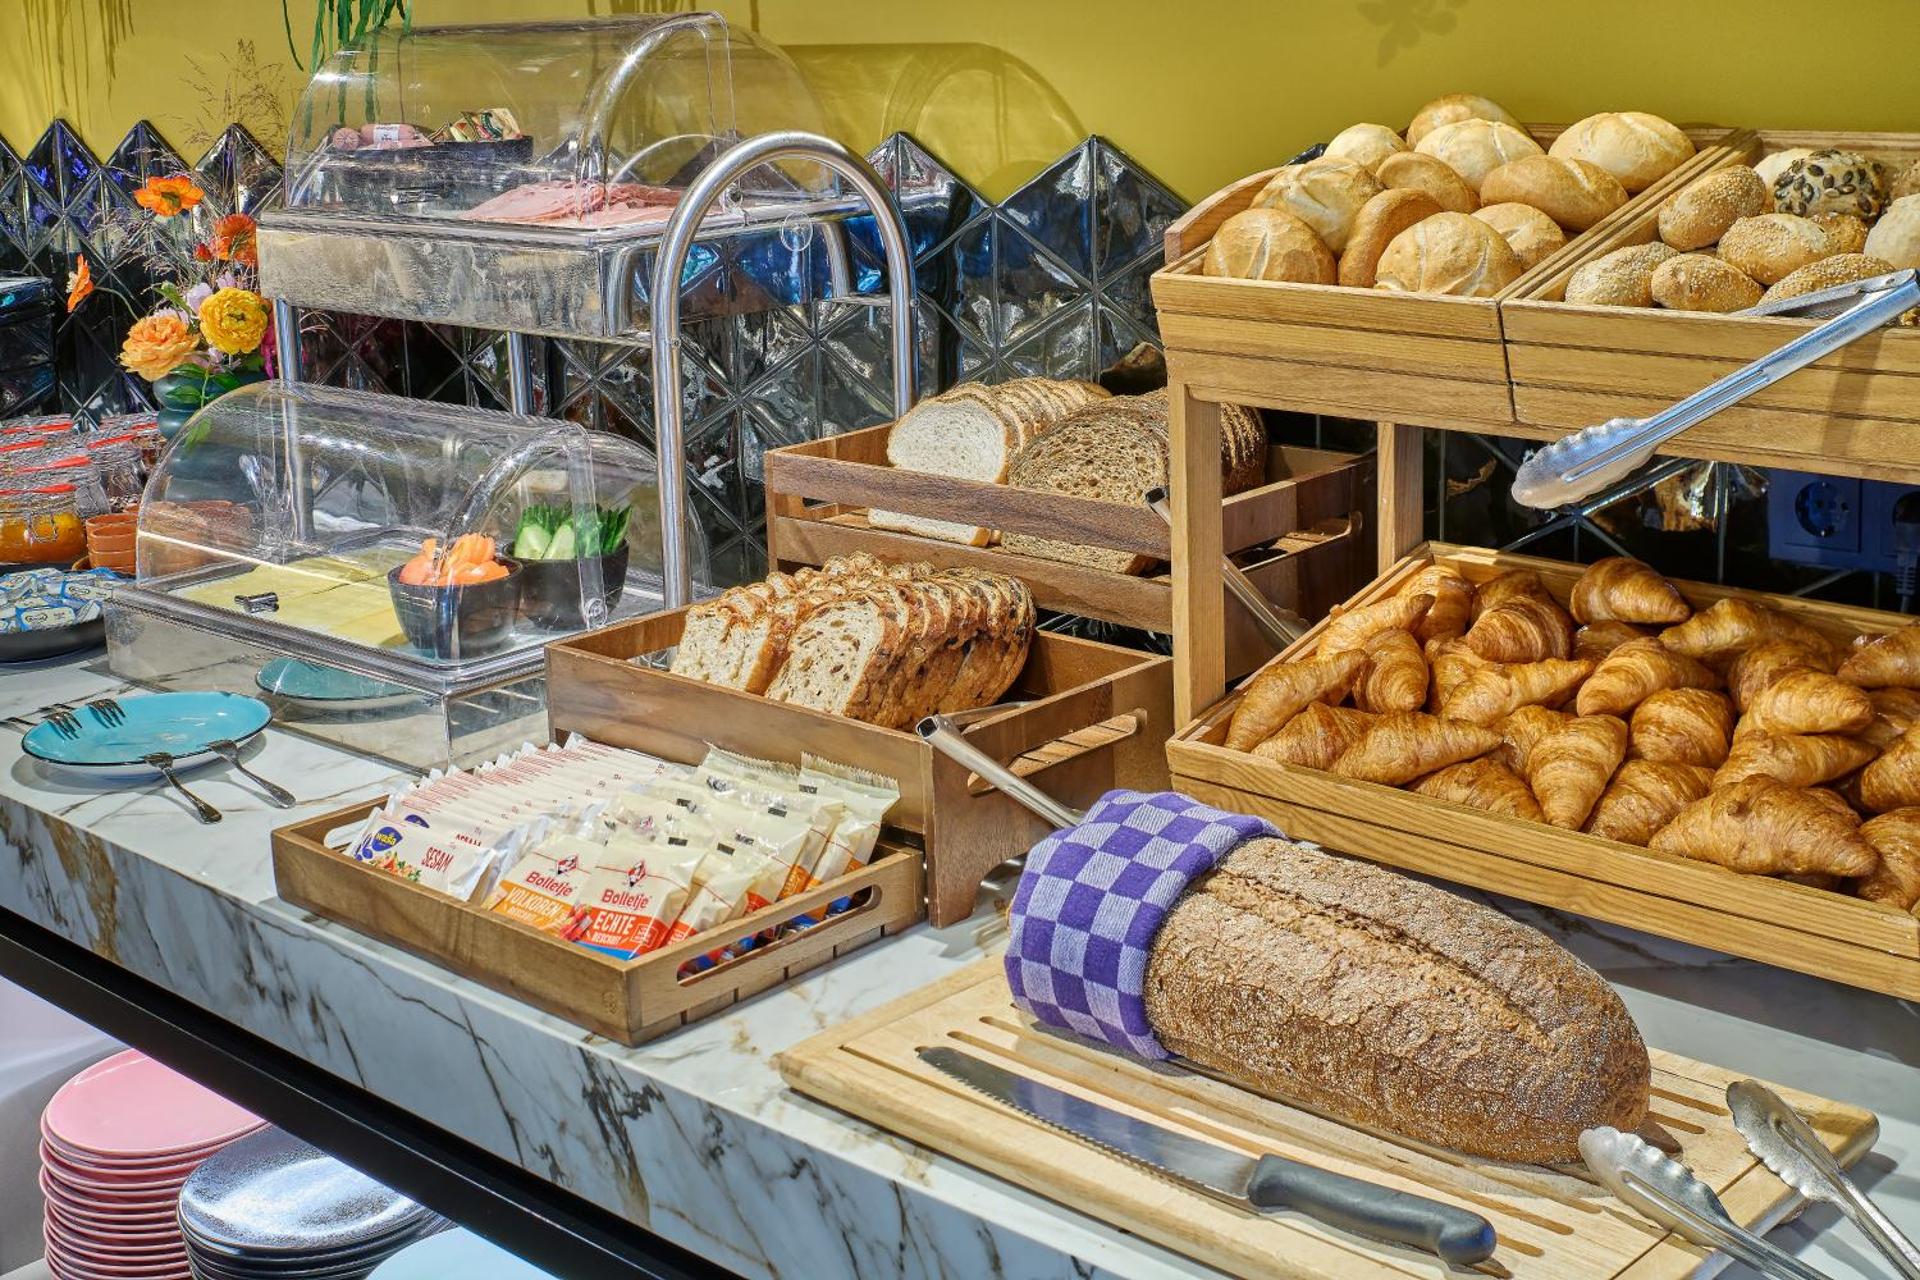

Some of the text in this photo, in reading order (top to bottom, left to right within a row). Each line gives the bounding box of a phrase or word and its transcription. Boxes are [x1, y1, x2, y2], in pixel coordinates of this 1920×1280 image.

[376, 832, 397, 847] wasa
[421, 846, 455, 873] SESAM
[526, 870, 574, 897] Bolletje
[509, 886, 562, 918] VOLKOREN
[601, 888, 649, 910] Bolletje
[593, 911, 636, 935] ECHTE
